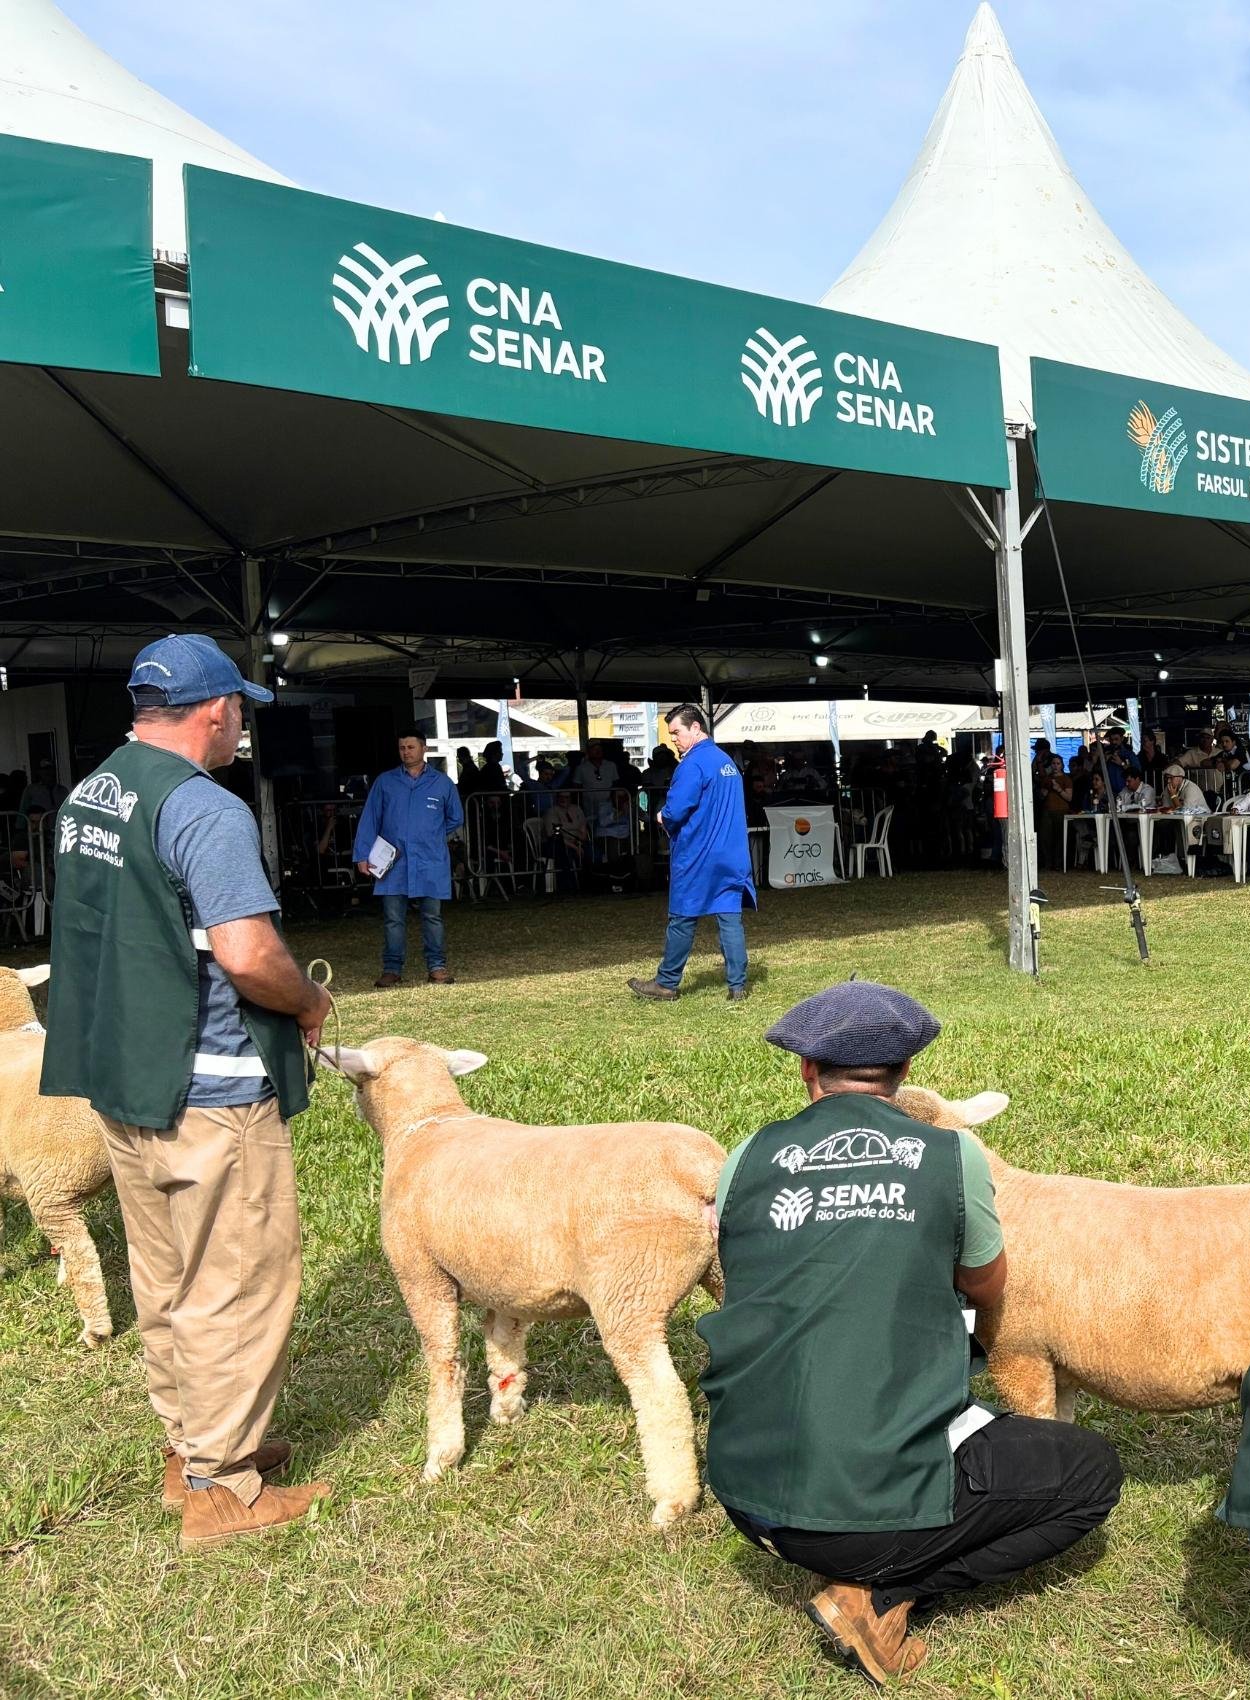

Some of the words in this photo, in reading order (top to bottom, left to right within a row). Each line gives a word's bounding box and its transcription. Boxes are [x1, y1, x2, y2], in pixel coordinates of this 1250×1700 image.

[466, 278, 562, 331] CNA
[468, 324, 607, 383] SENAR
[834, 352, 903, 393] CNA
[836, 391, 937, 436] SENAR
[1197, 472, 1248, 498] FARSUL
[80, 824, 120, 853] SENAR
[80, 844, 93, 856] Rio
[784, 843, 822, 859] AGRO
[784, 869, 824, 885] amais
[818, 1183, 906, 1207] SENAR
[815, 1210, 833, 1222] Rio
[835, 1204, 876, 1220] Grande
[878, 1206, 895, 1219] do
[896, 1207, 916, 1223] Sul
